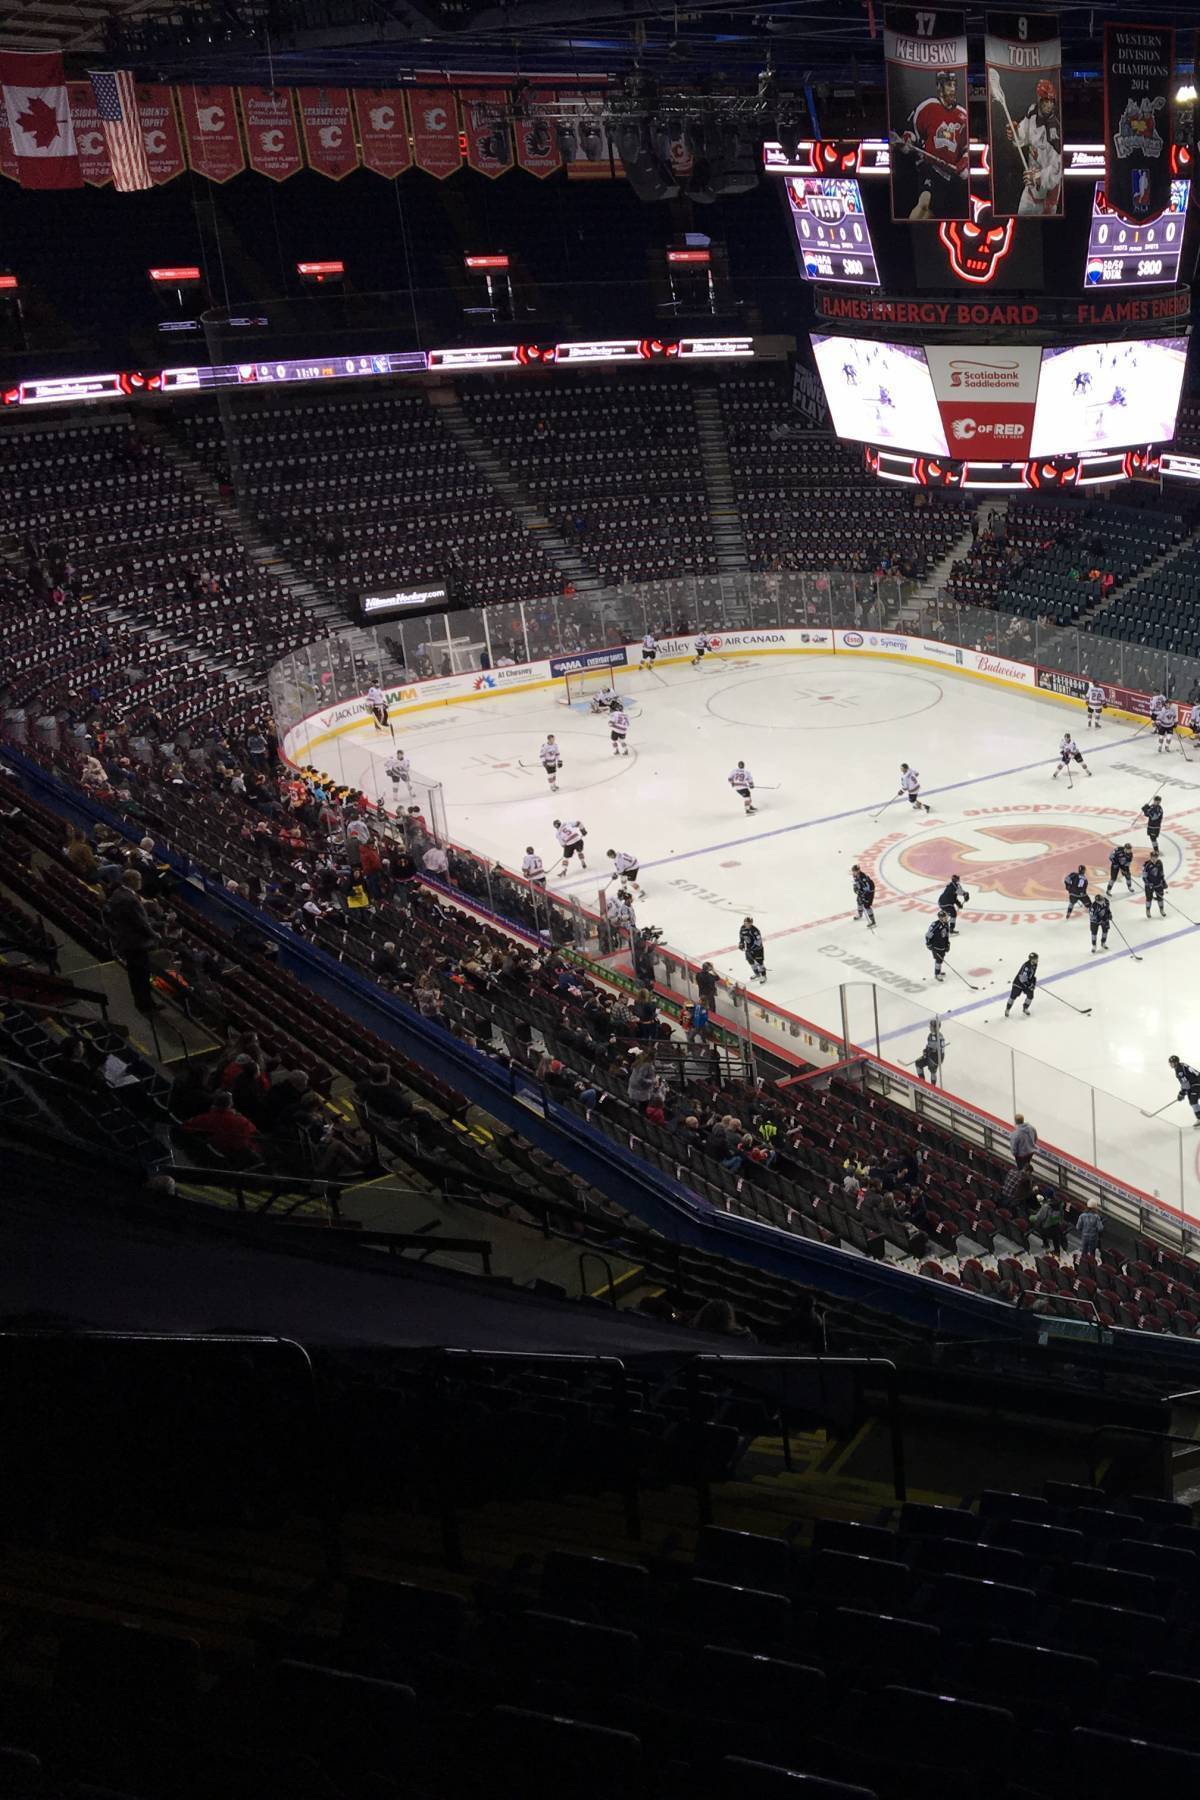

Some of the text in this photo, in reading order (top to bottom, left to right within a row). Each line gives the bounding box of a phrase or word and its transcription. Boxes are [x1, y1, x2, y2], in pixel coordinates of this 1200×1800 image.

[915, 12, 936, 36] 17
[1017, 17, 1029, 40] 9
[1116, 33, 1163, 48] WESTERN
[895, 38, 957, 64] KELUSKY
[1007, 45, 1040, 67] TOTH
[1118, 48, 1161, 62] DIVISION
[1111, 63, 1168, 77] CHAMPIONS
[1131, 78, 1150, 90] 2014
[811, 198, 841, 219] 11:19
[1098, 224, 1108, 244] 0
[1166, 222, 1176, 241] 0
[1137, 260, 1162, 276] $800
[822, 297, 1039, 325] FLAMES ENERGY BOARD
[1077, 302, 1149, 324] FLAMES
[963, 371, 1019, 380] Scotiabank
[963, 379, 1020, 389] Saddledome
[977, 424, 993, 435] OF
[994, 423, 1025, 436] RED
[365, 591, 445, 611] HitmenHockey.com
[725, 634, 785, 646] AIR CANADA
[847, 636, 861, 644] Esso
[880, 637, 908, 651] Synergy
[559, 660, 582, 672] AMA
[976, 656, 1027, 681] Budweiser
[335, 706, 352, 722] JACK
